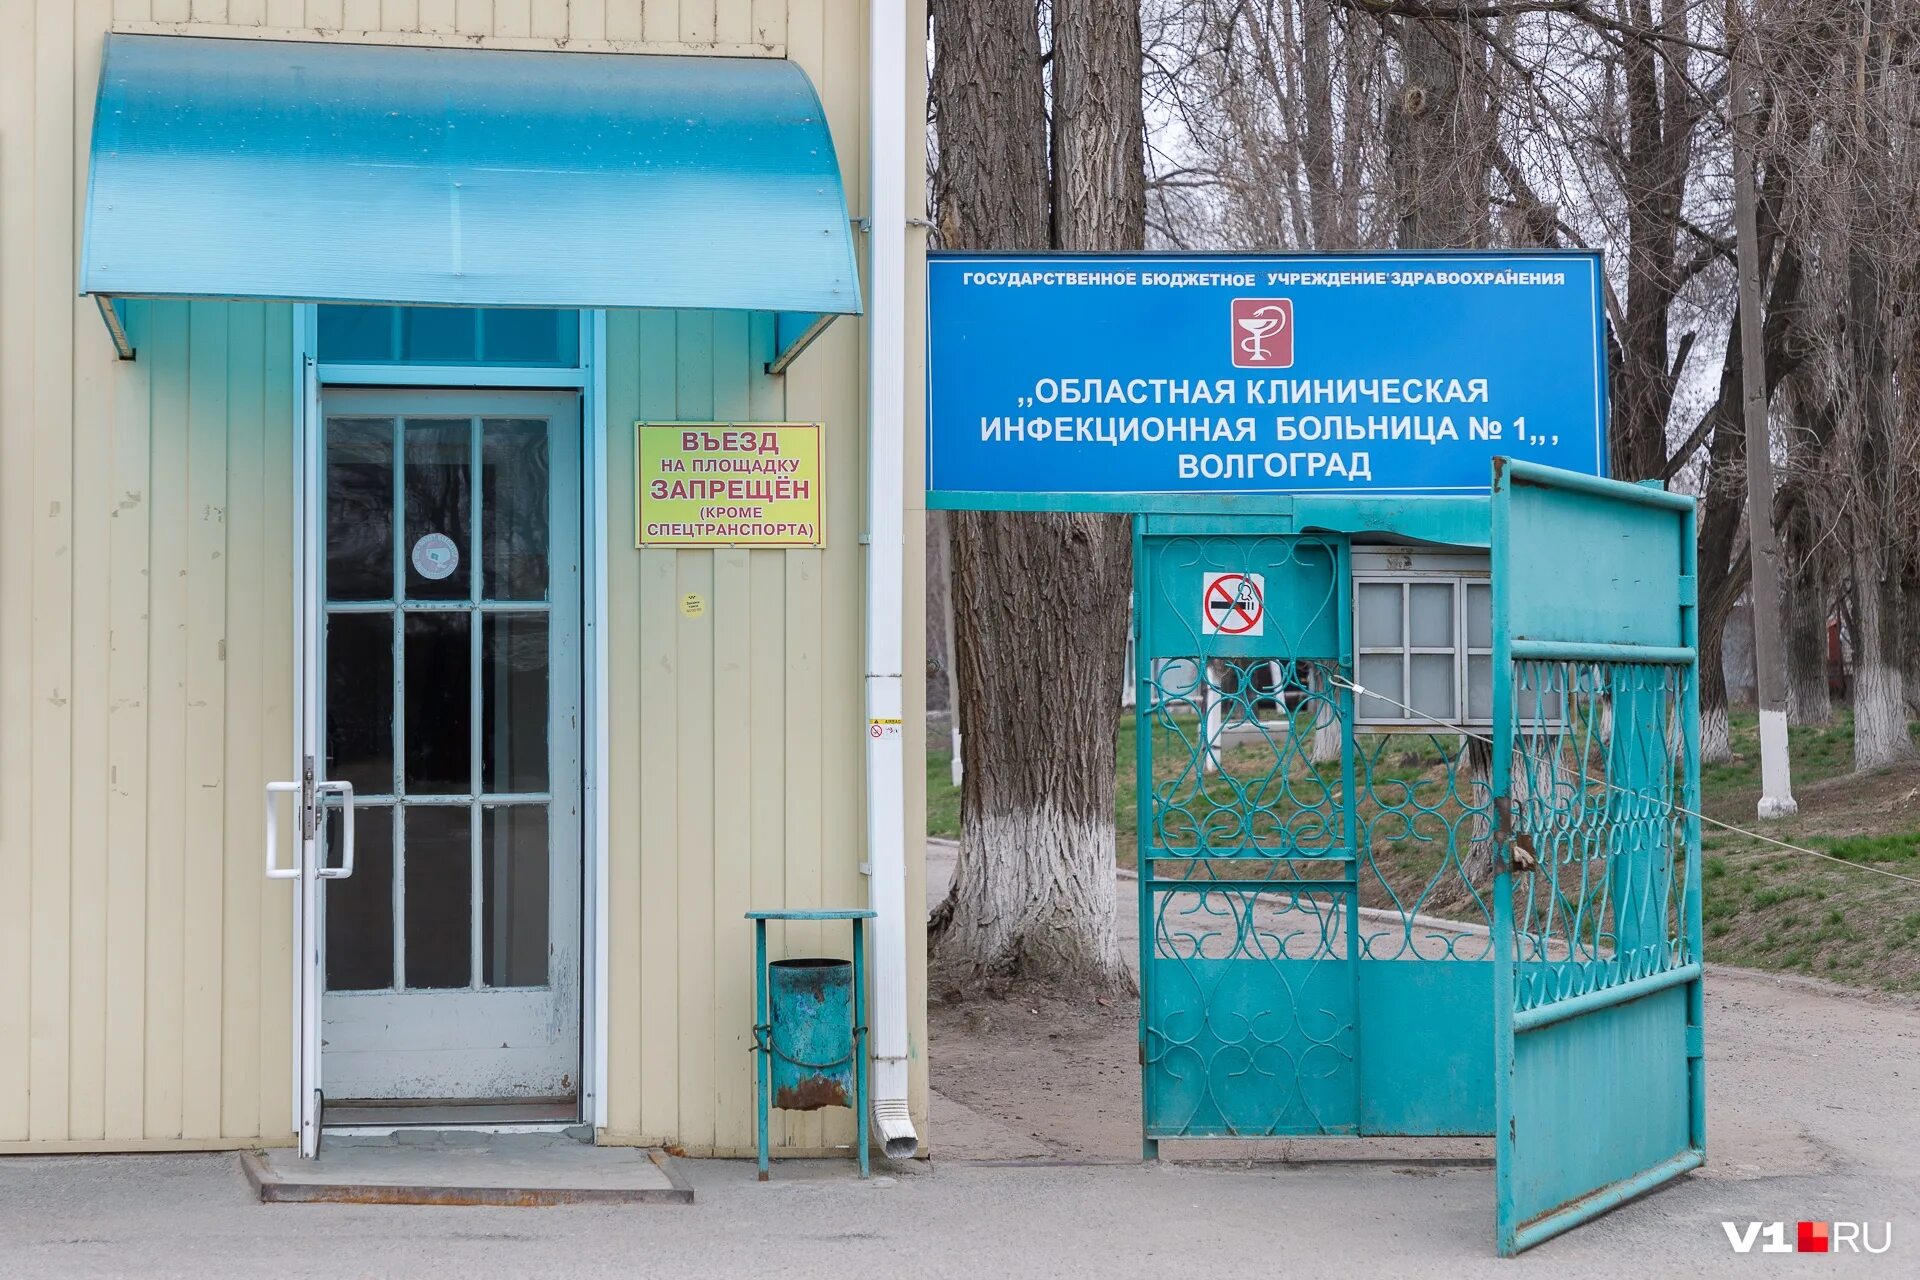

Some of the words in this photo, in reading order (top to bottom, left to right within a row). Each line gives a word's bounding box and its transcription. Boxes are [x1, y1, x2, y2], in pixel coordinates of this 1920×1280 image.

[963, 272, 1137, 287] ГОСУДАРСТВЕННОЕ
[1142, 272, 1256, 287] БЮДЖЕТНОЕ
[1268, 272, 1386, 287] УЧРЕЖДЕНИЕ
[1391, 271, 1565, 287] ЗДРАВООХРАНЕНИЯ
[1247, 378, 1489, 404] КЛИНИЧЕСКАЯ
[682, 431, 779, 456] ВЪЕЗД
[980, 416, 1257, 447] ИНФЕКЦИОННАЯ
[1276, 415, 1459, 445] БОЛЬНИЦА
[1468, 416, 1503, 441] №
[661, 459, 685, 472] НА
[692, 459, 800, 475] ПЛОЩАДКУ
[1178, 452, 1372, 482] ВОЛГОГРАД
[651, 475, 810, 503] ЗАПРЕЩЁН
[700, 506, 763, 521] (КРОМЕ
[647, 523, 814, 538] СПЕЦТРАНСПОРТА)
